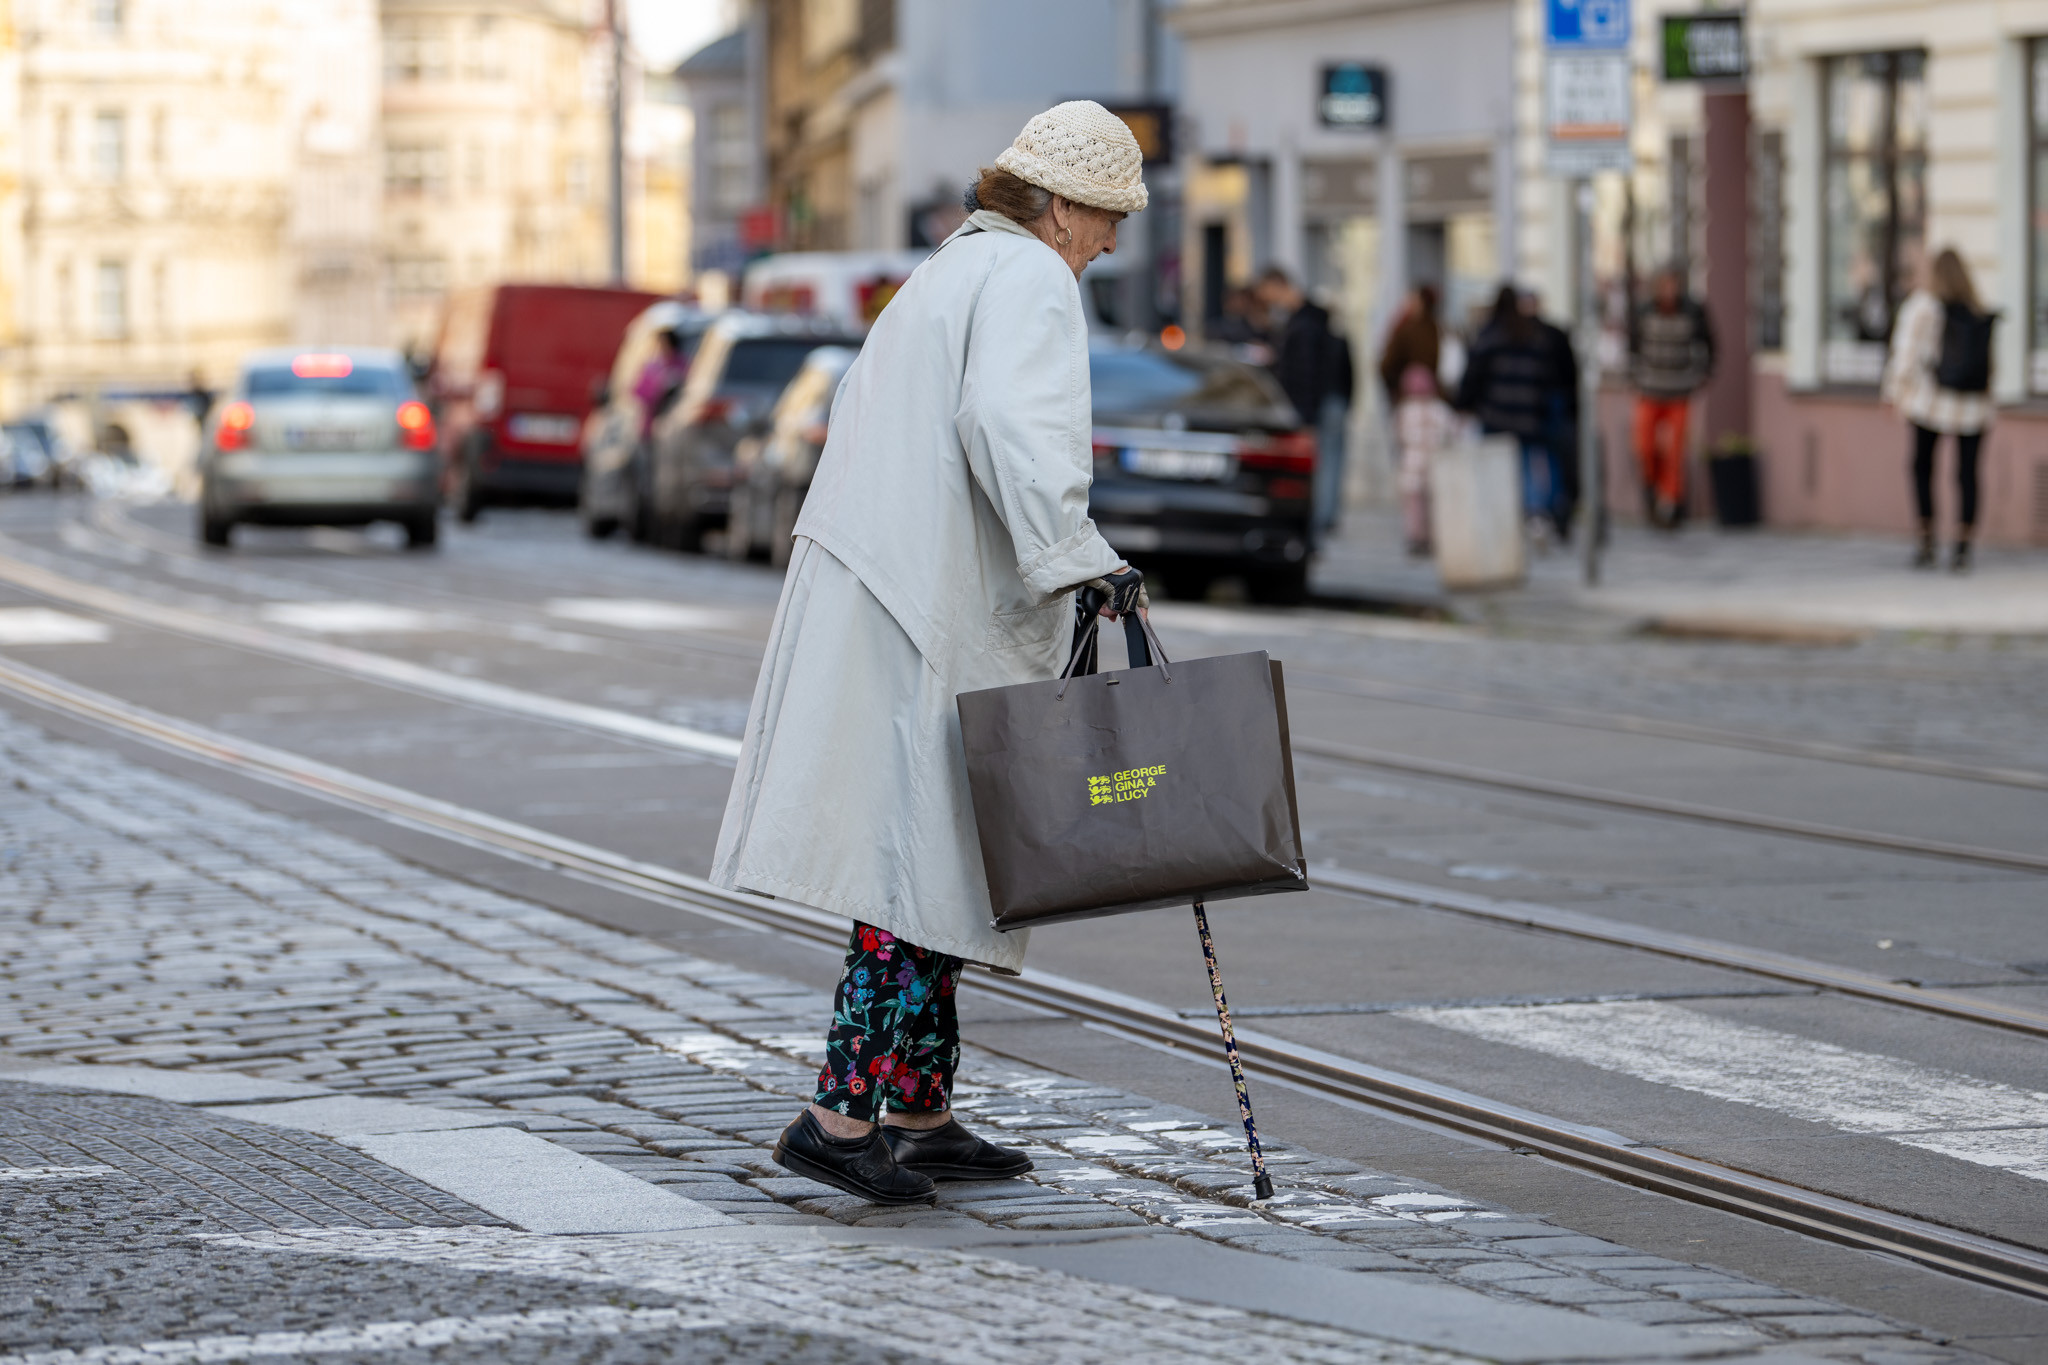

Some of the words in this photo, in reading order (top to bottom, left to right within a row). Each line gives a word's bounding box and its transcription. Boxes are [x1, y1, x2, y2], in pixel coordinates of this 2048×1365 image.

[1114, 765, 1166, 782] GEORGE
[1115, 779, 1145, 792] GINA
[1147, 777, 1156, 787] &
[1116, 788, 1149, 802] LUCY
